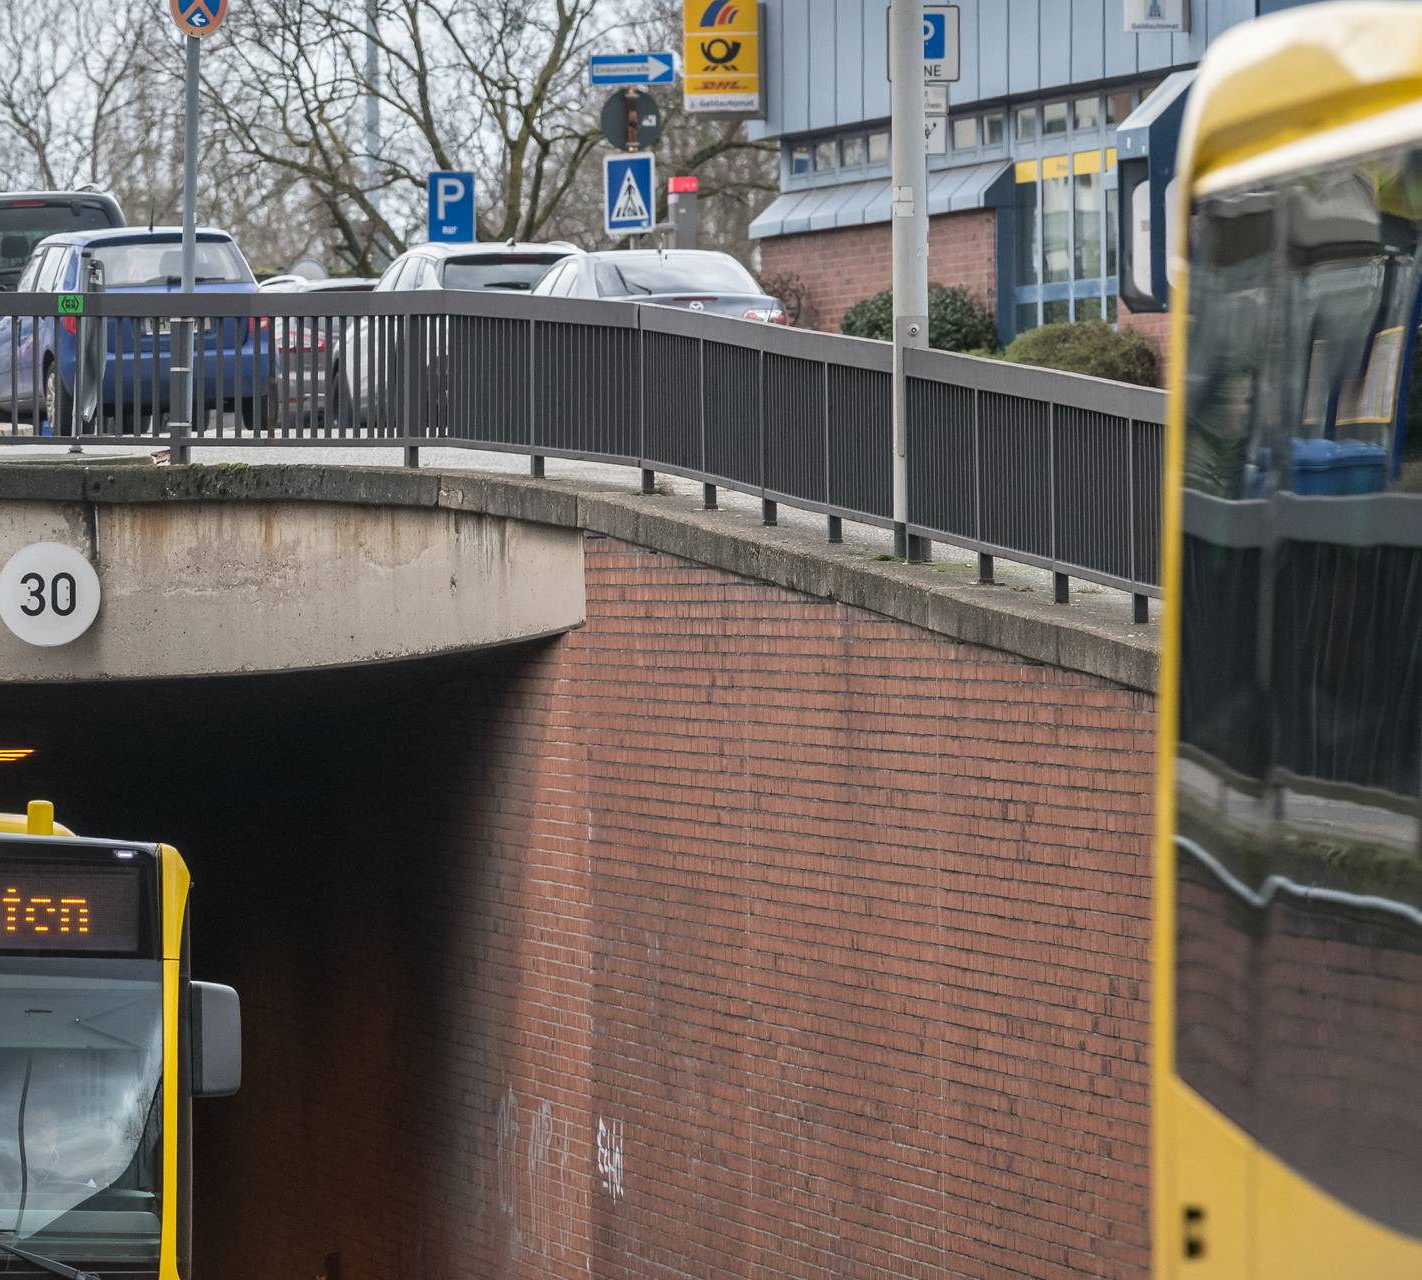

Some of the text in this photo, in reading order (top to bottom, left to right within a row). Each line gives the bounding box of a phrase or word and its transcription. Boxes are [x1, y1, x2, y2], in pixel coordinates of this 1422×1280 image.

[923, 64, 942, 77] NE
[700, 81, 741, 90] DHL
[437, 178, 465, 220] P
[20, 572, 76, 616] 30
